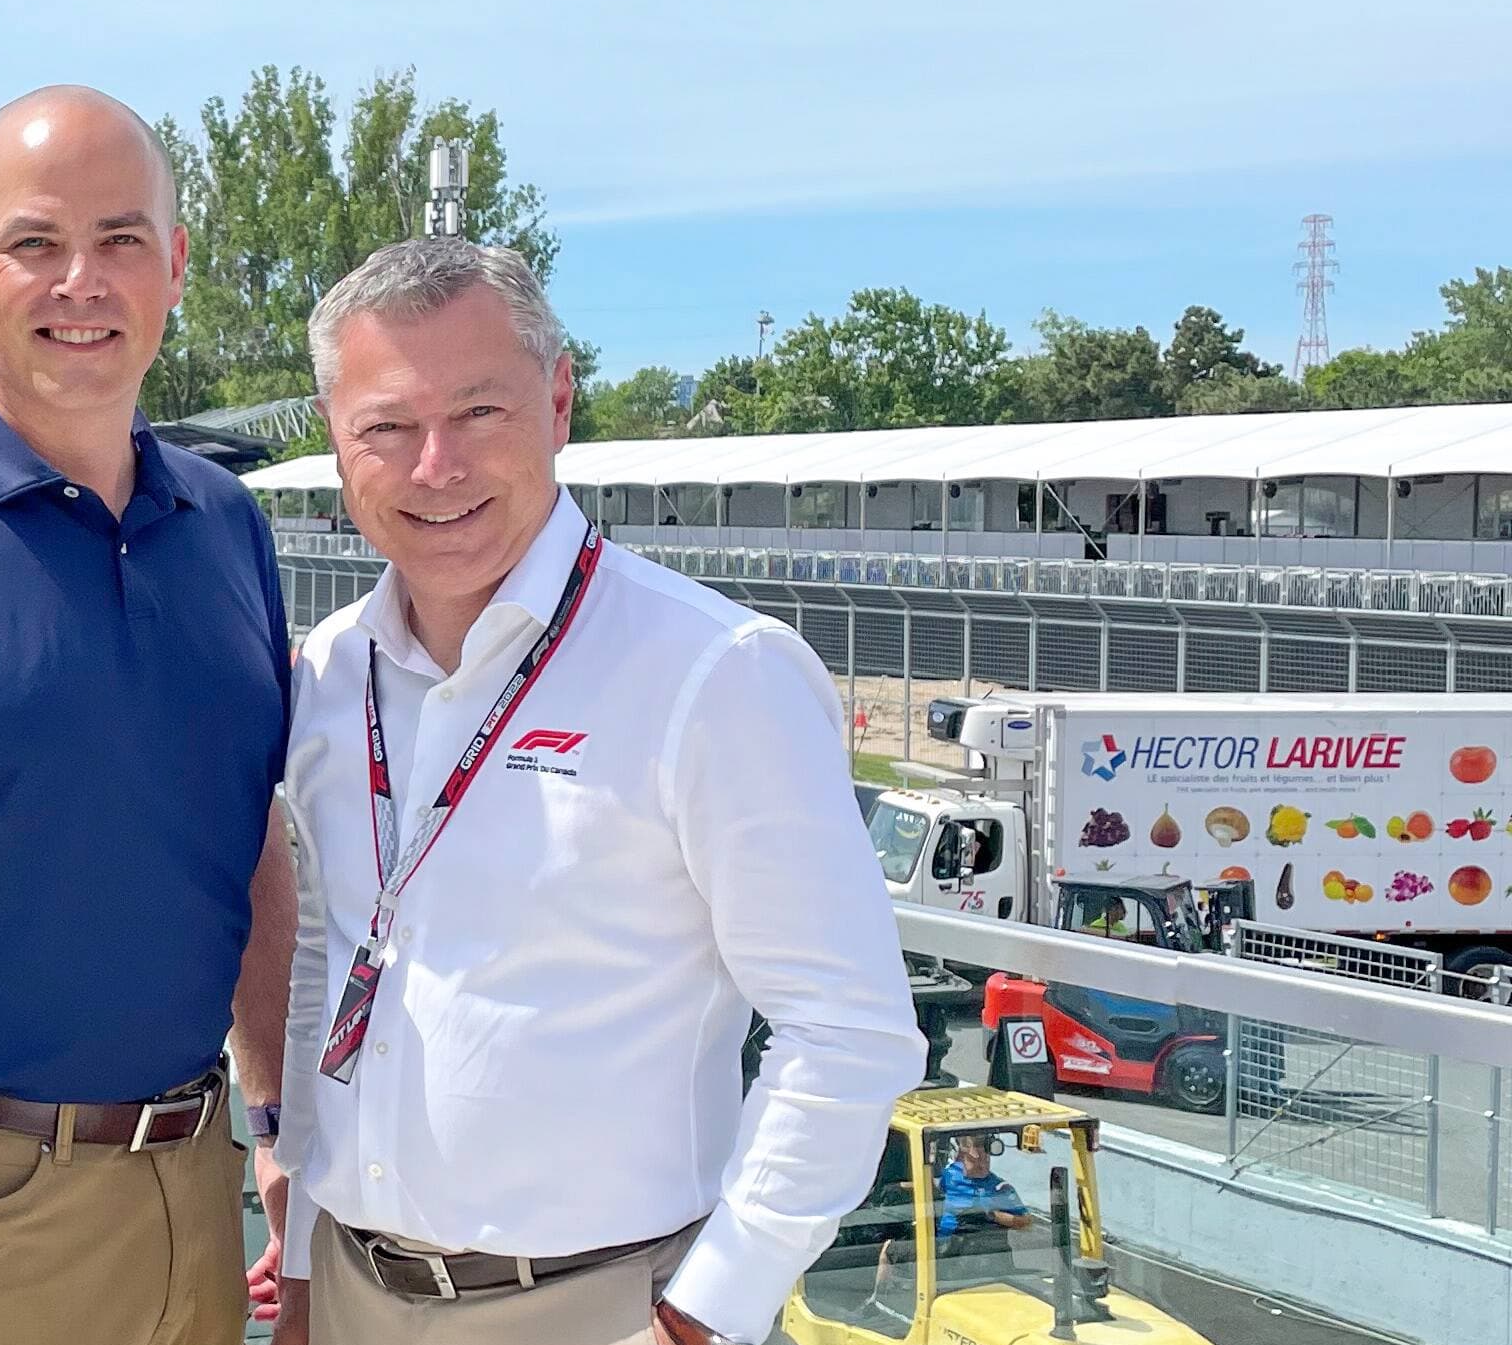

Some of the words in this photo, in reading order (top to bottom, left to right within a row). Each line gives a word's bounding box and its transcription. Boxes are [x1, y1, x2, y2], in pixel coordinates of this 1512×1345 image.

[459, 735, 486, 771] GRID
[499, 673, 526, 709] 2022
[510, 728, 589, 755] F1
[1130, 736, 1259, 769] HECTOR
[1266, 732, 1407, 769] LARIVÉE
